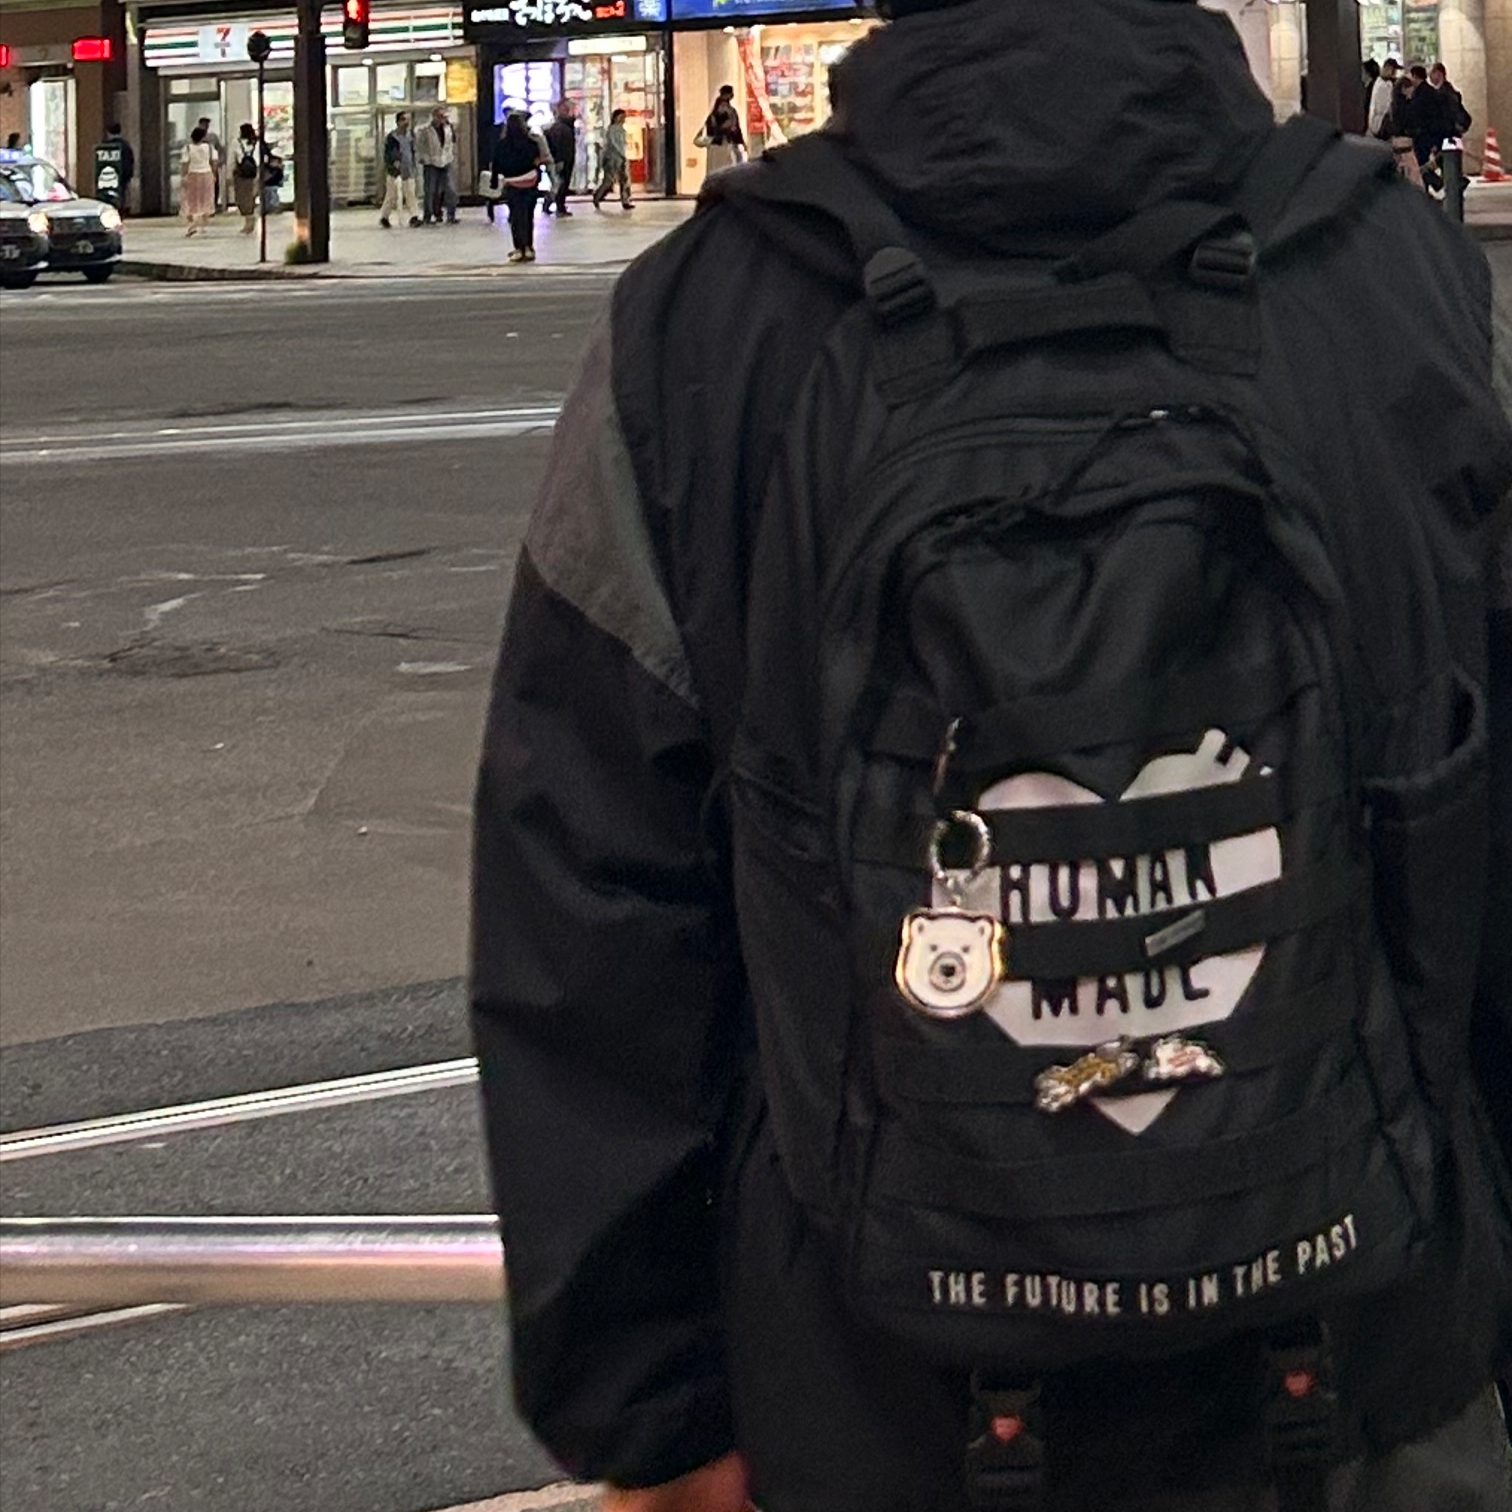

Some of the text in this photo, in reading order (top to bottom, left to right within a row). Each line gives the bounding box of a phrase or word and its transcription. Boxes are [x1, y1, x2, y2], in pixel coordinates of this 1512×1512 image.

[929, 1212, 1358, 1316] THE FUTURE IS IN THE PAST
